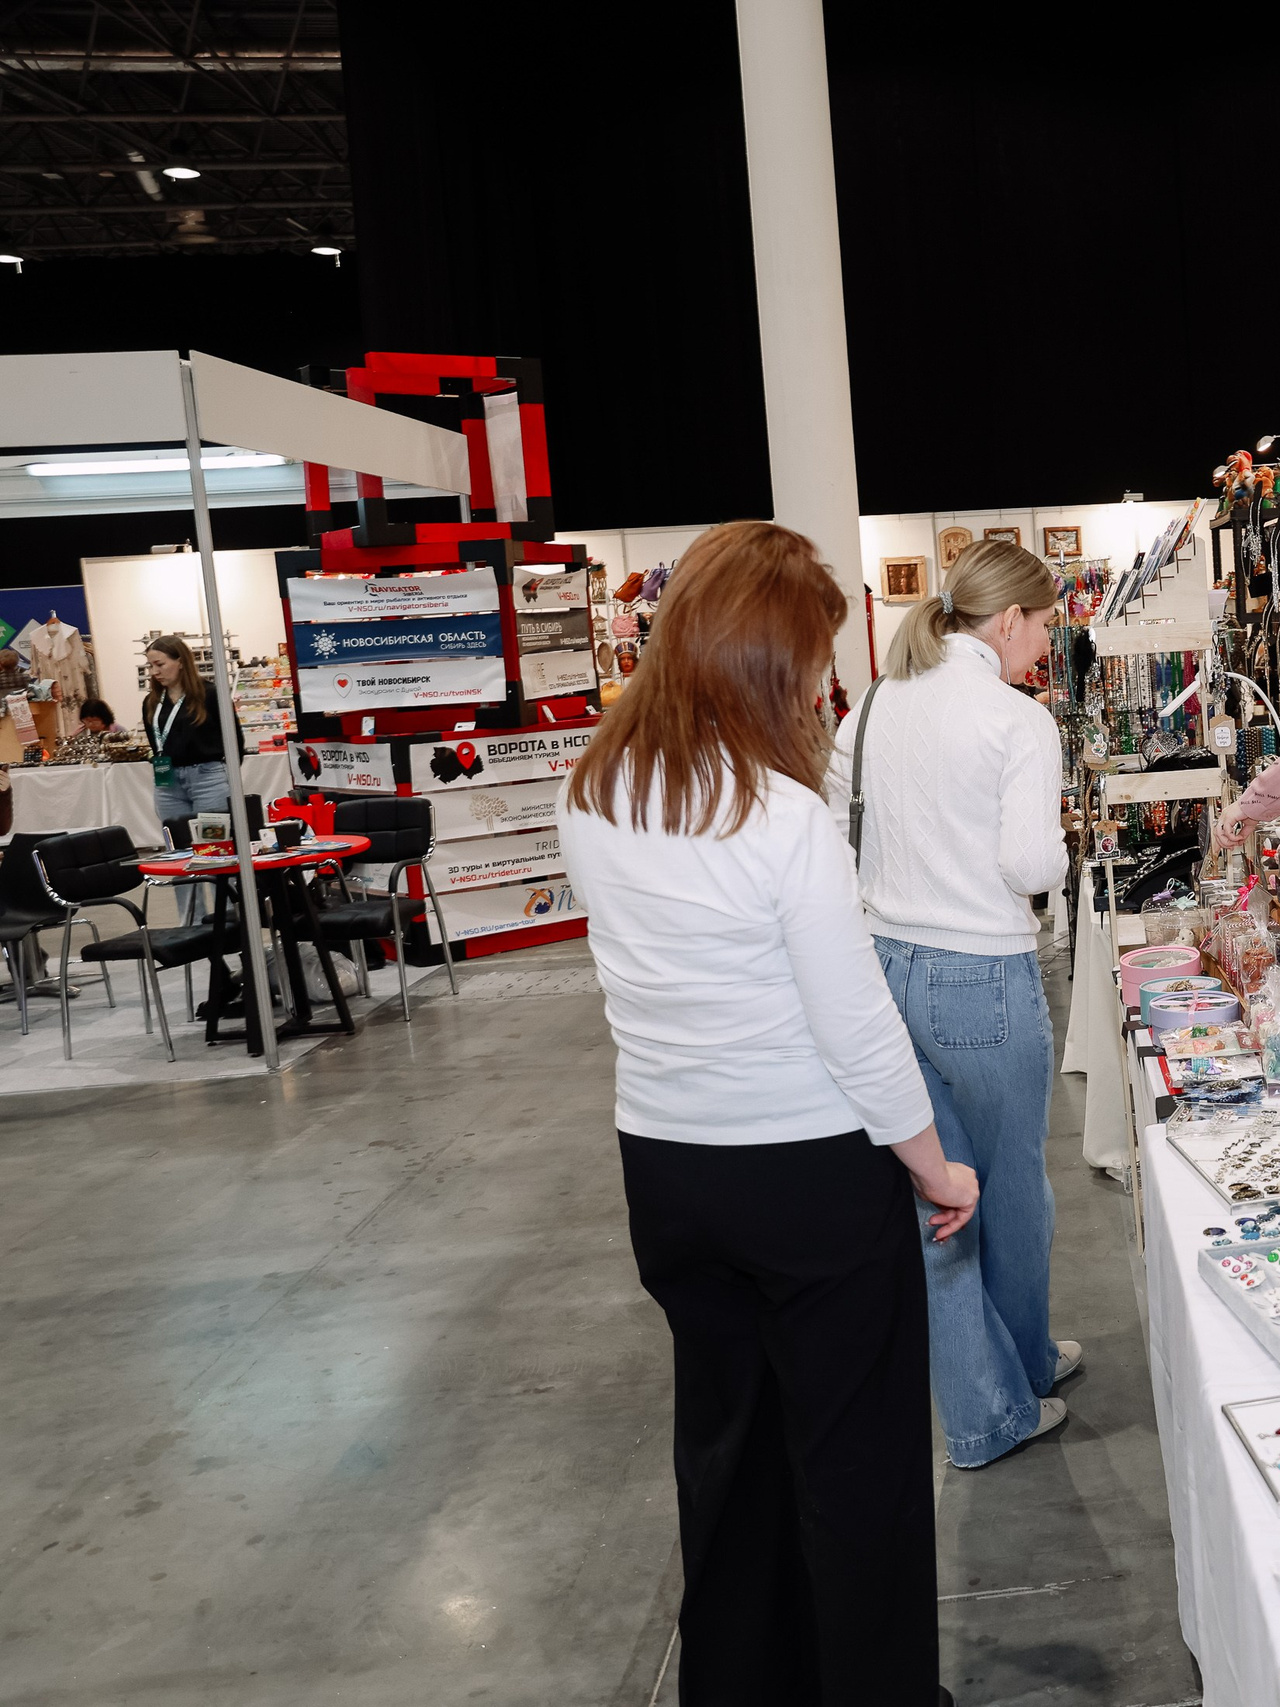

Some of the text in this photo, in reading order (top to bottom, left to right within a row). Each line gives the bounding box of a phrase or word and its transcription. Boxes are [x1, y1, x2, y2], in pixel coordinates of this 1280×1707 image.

[370, 585, 421, 593] NAVIGATOR
[348, 601, 449, 613] V-NSO.ru/navigatorsiberia
[521, 623, 536, 634] ПУТЬ
[342, 631, 487, 648] НОВОСИБИРСКАЯ ОБЛАСТЬ
[466, 641, 487, 649] ЗДЕСЬ
[356, 676, 431, 687] ТВОЙ НОВОСИБИРСК
[414, 688, 483, 699] V-NSO.ru/tvoiNSK
[487, 734, 591, 756] ВОРОТА в НСО
[321, 750, 348, 762] ВОРОТА
[350, 754, 355, 762] в
[488, 751, 560, 764] ОБЪЕДИНЯЕМ ТУРИЗМ
[347, 773, 381, 786] V-NSO.ru
[448, 866, 460, 874] 3D
[461, 864, 483, 873] туры
[492, 854, 546, 867] виртуальные
[450, 866, 532, 884] V-NSO.ru/tridetur.ru
[455, 918, 536, 937] V-NSO.RU/parnas-tour
